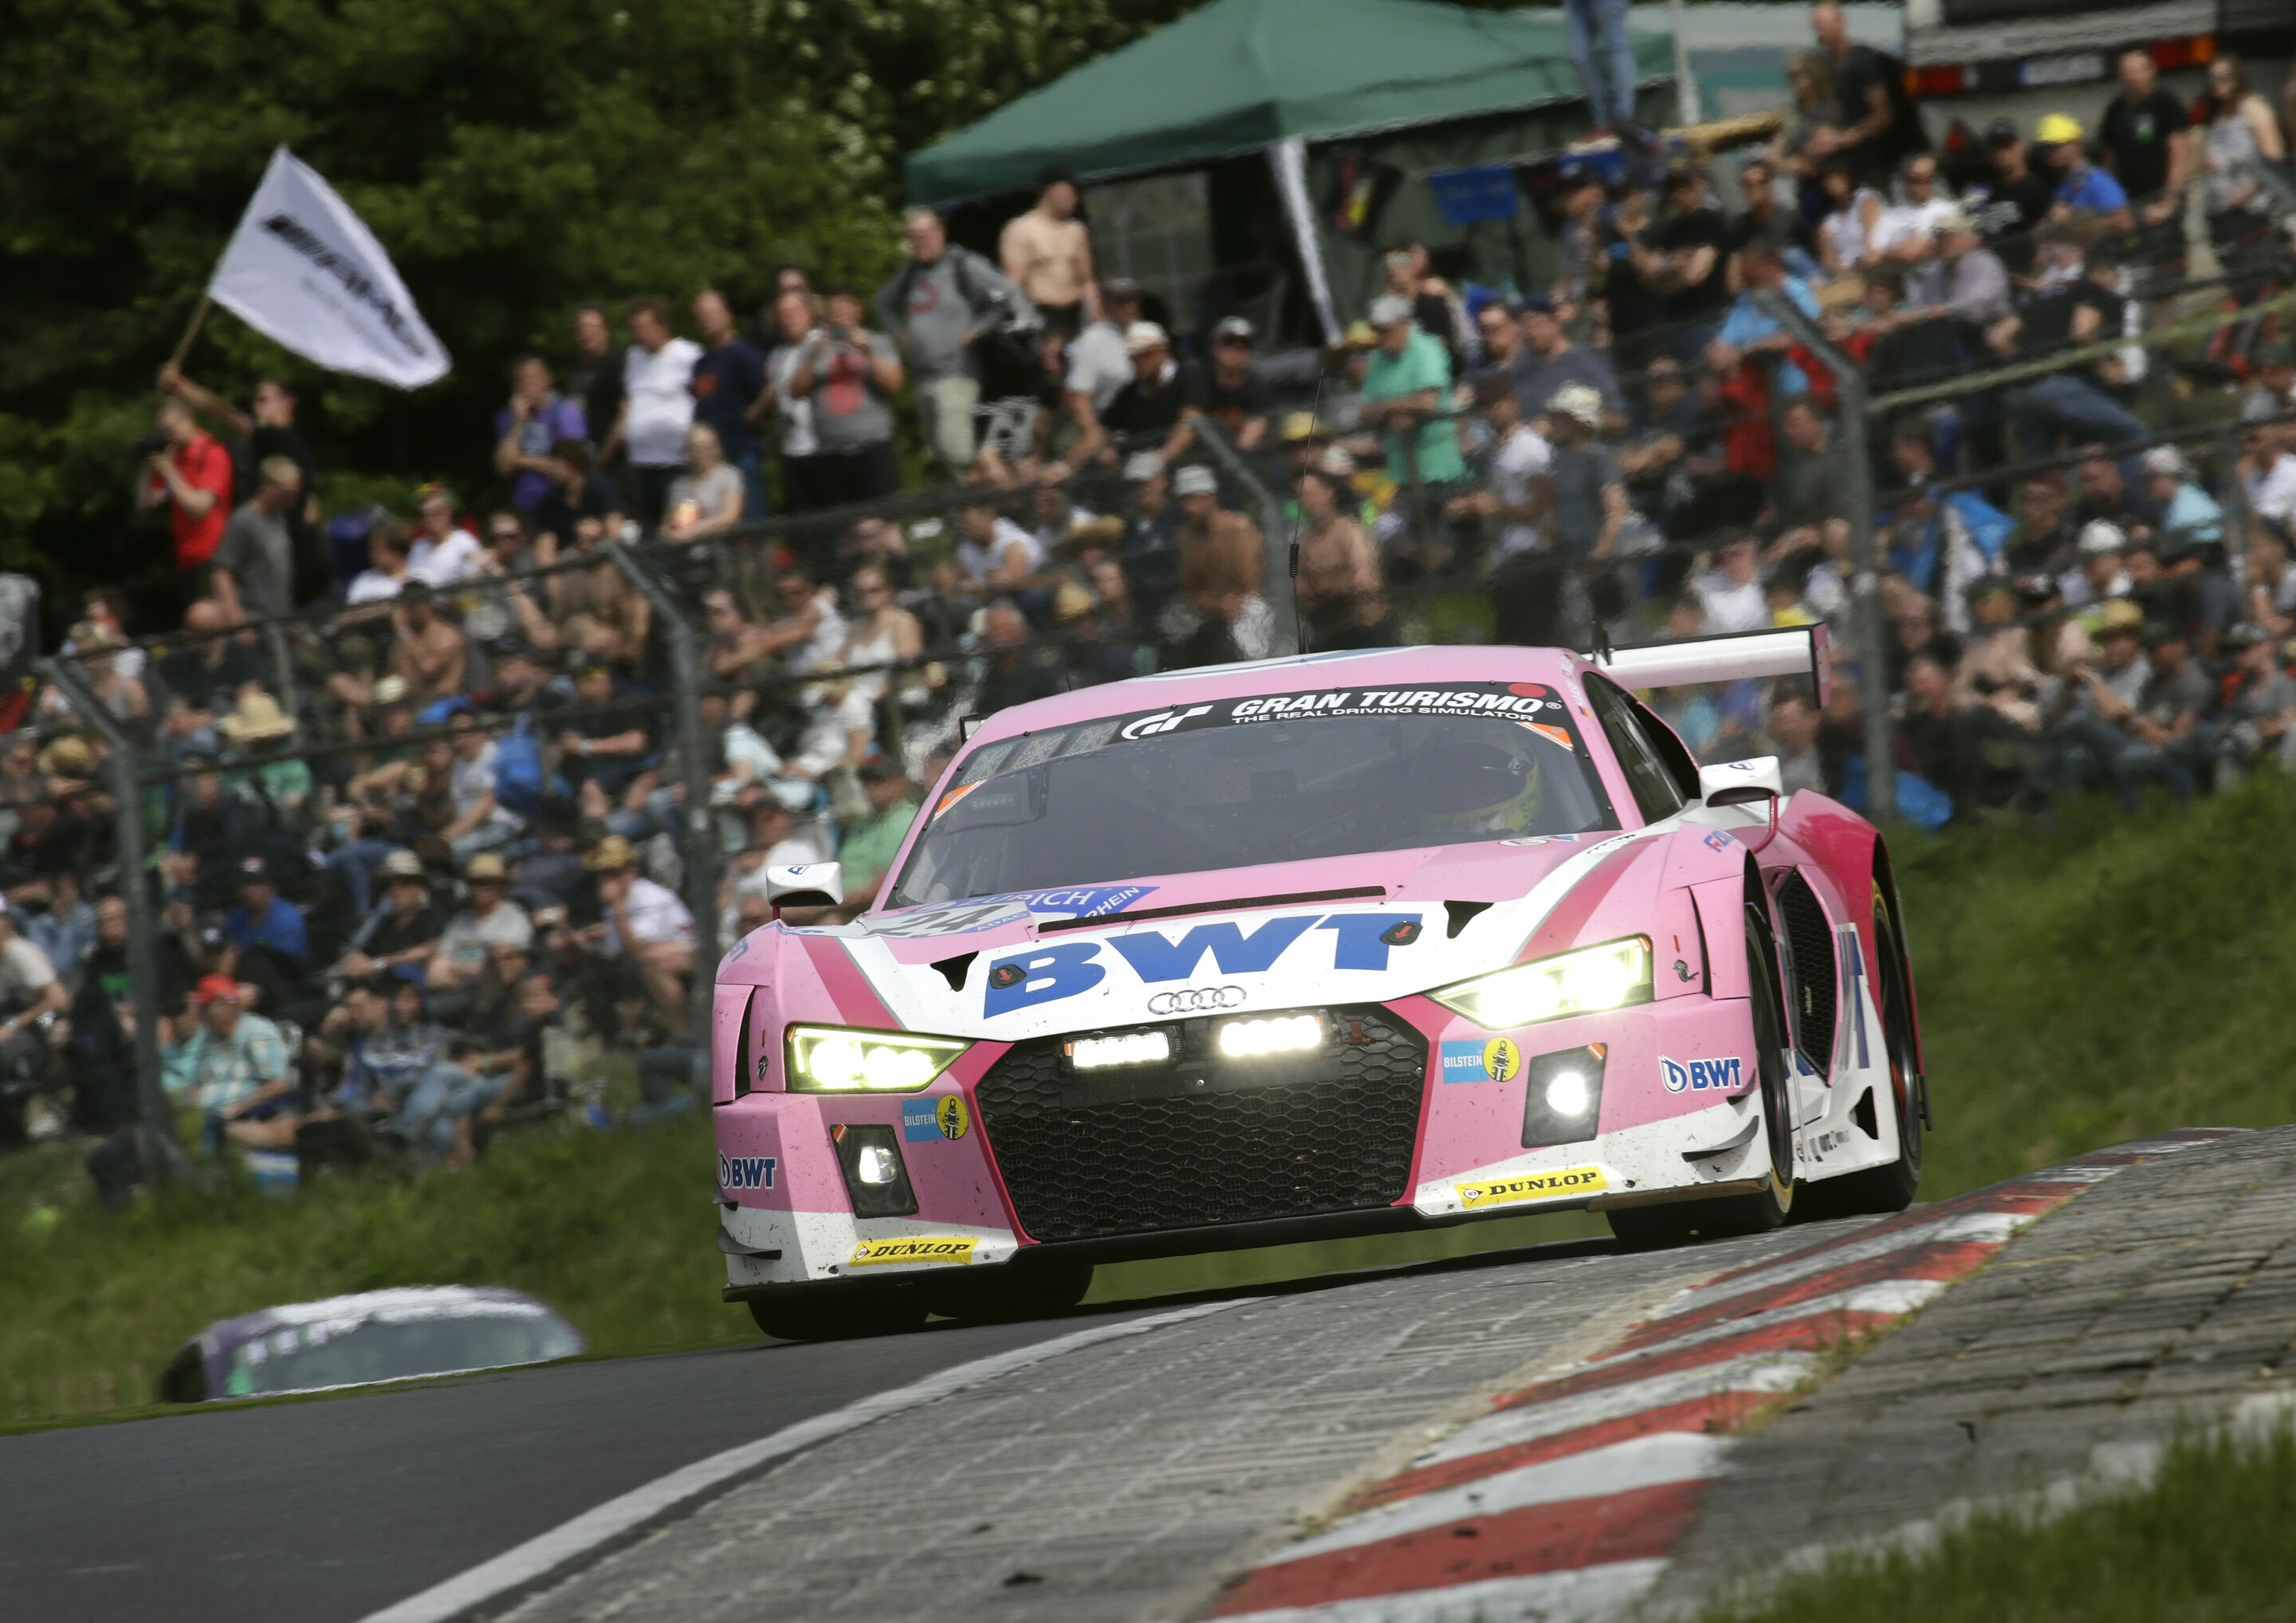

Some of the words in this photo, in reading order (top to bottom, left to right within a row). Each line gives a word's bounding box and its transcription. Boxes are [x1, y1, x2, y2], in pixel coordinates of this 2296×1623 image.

[1232, 693, 1351, 716] GRAN
[1232, 713, 1270, 724] THE
[1277, 710, 1327, 720] REAL
[1332, 707, 1413, 716] DRIVING
[1417, 707, 1534, 721] SIMULATOR
[984, 913, 1422, 1020] BWT
[1443, 1055, 1483, 1068] BILSTEIN
[1689, 1058, 1741, 1090] BWT
[903, 1114, 938, 1126] BILSTEIN
[731, 1157, 776, 1188] BWT
[1488, 1171, 1598, 1197] DUNLOP
[870, 1243, 970, 1259] DUNLOP
